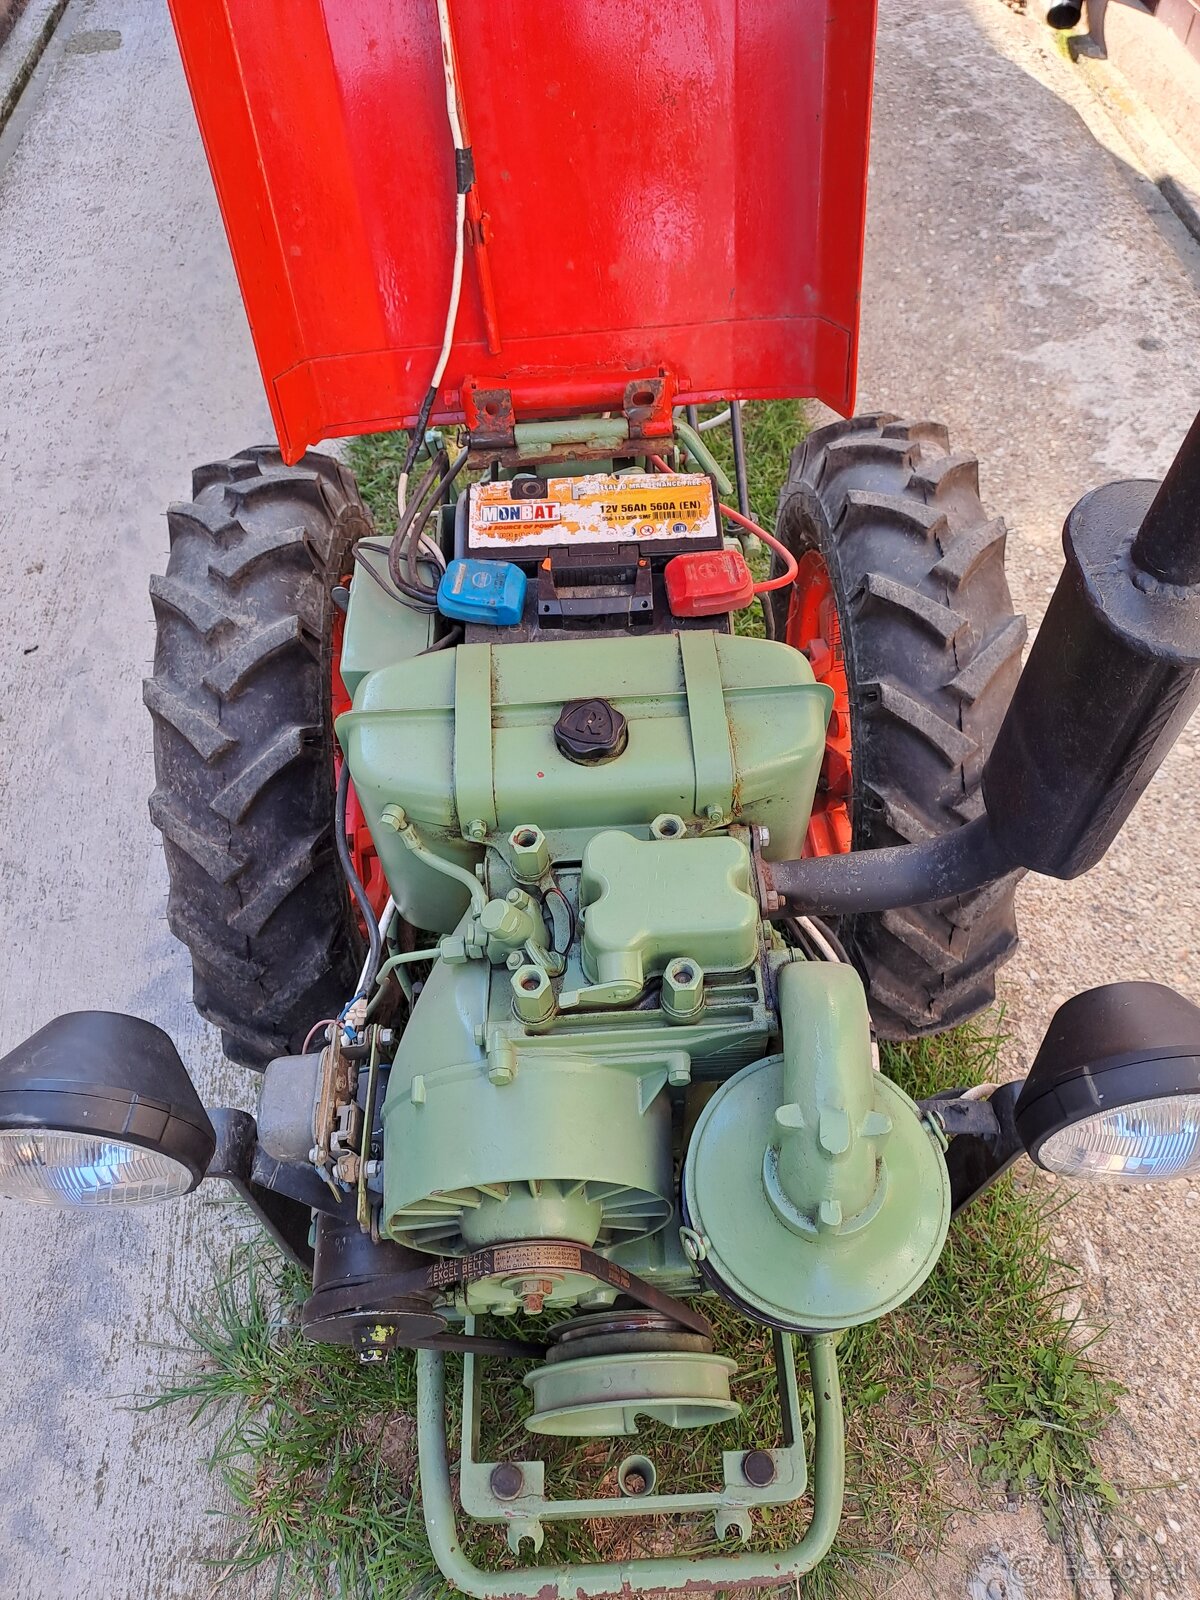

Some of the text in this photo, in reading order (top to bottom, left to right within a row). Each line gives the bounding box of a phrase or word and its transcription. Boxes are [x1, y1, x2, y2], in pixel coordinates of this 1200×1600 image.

[482, 505, 556, 522] MONBAT
[600, 500, 701, 514] 12V 56Ah 560A (EN)
[433, 1267, 459, 1282] EXCEL
[462, 1260, 483, 1274] BELT
